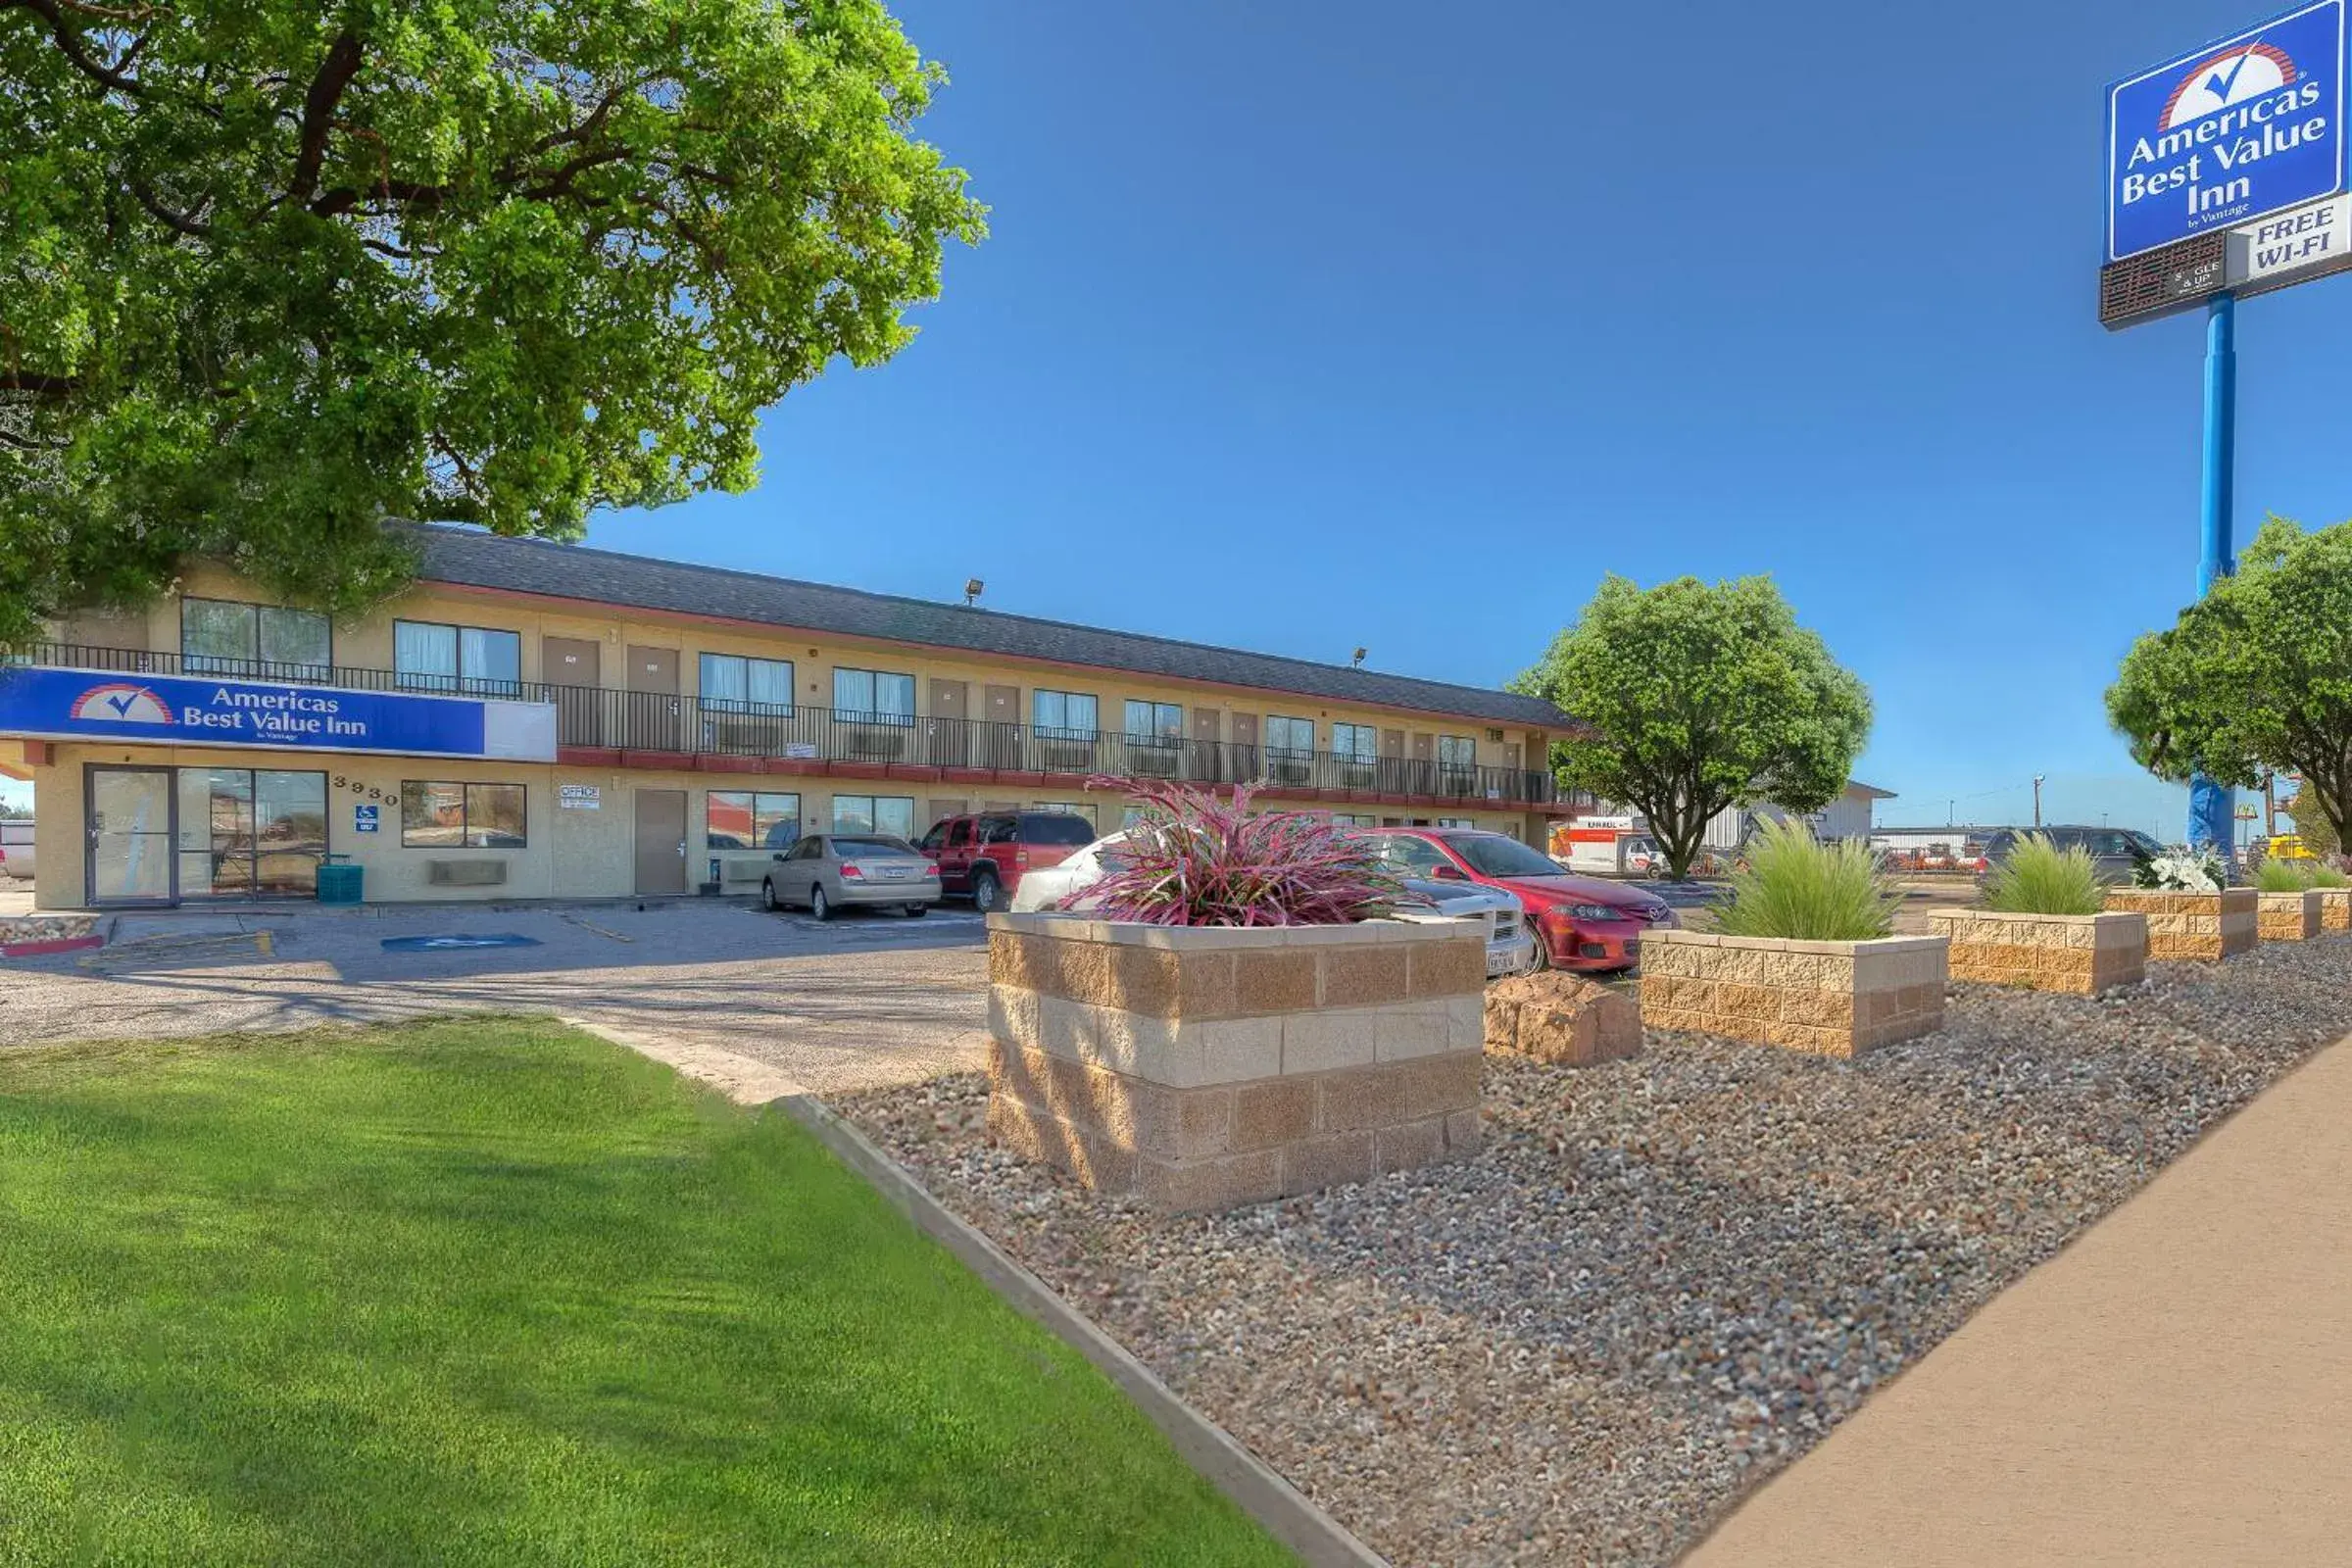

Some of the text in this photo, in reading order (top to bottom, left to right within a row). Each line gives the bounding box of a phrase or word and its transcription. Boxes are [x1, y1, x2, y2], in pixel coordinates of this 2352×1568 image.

[2127, 80, 2321, 171] Americas
[2123, 117, 2327, 205] Best Value
[2187, 176, 2250, 216] Inn
[2201, 203, 2250, 224] Vantage
[2257, 205, 2333, 245] FREE
[2256, 231, 2331, 269] WI-FI
[212, 687, 339, 713] Americas
[184, 706, 368, 736] Best Value Inn
[333, 776, 398, 807] 3930
[562, 786, 600, 799] OFFICE
